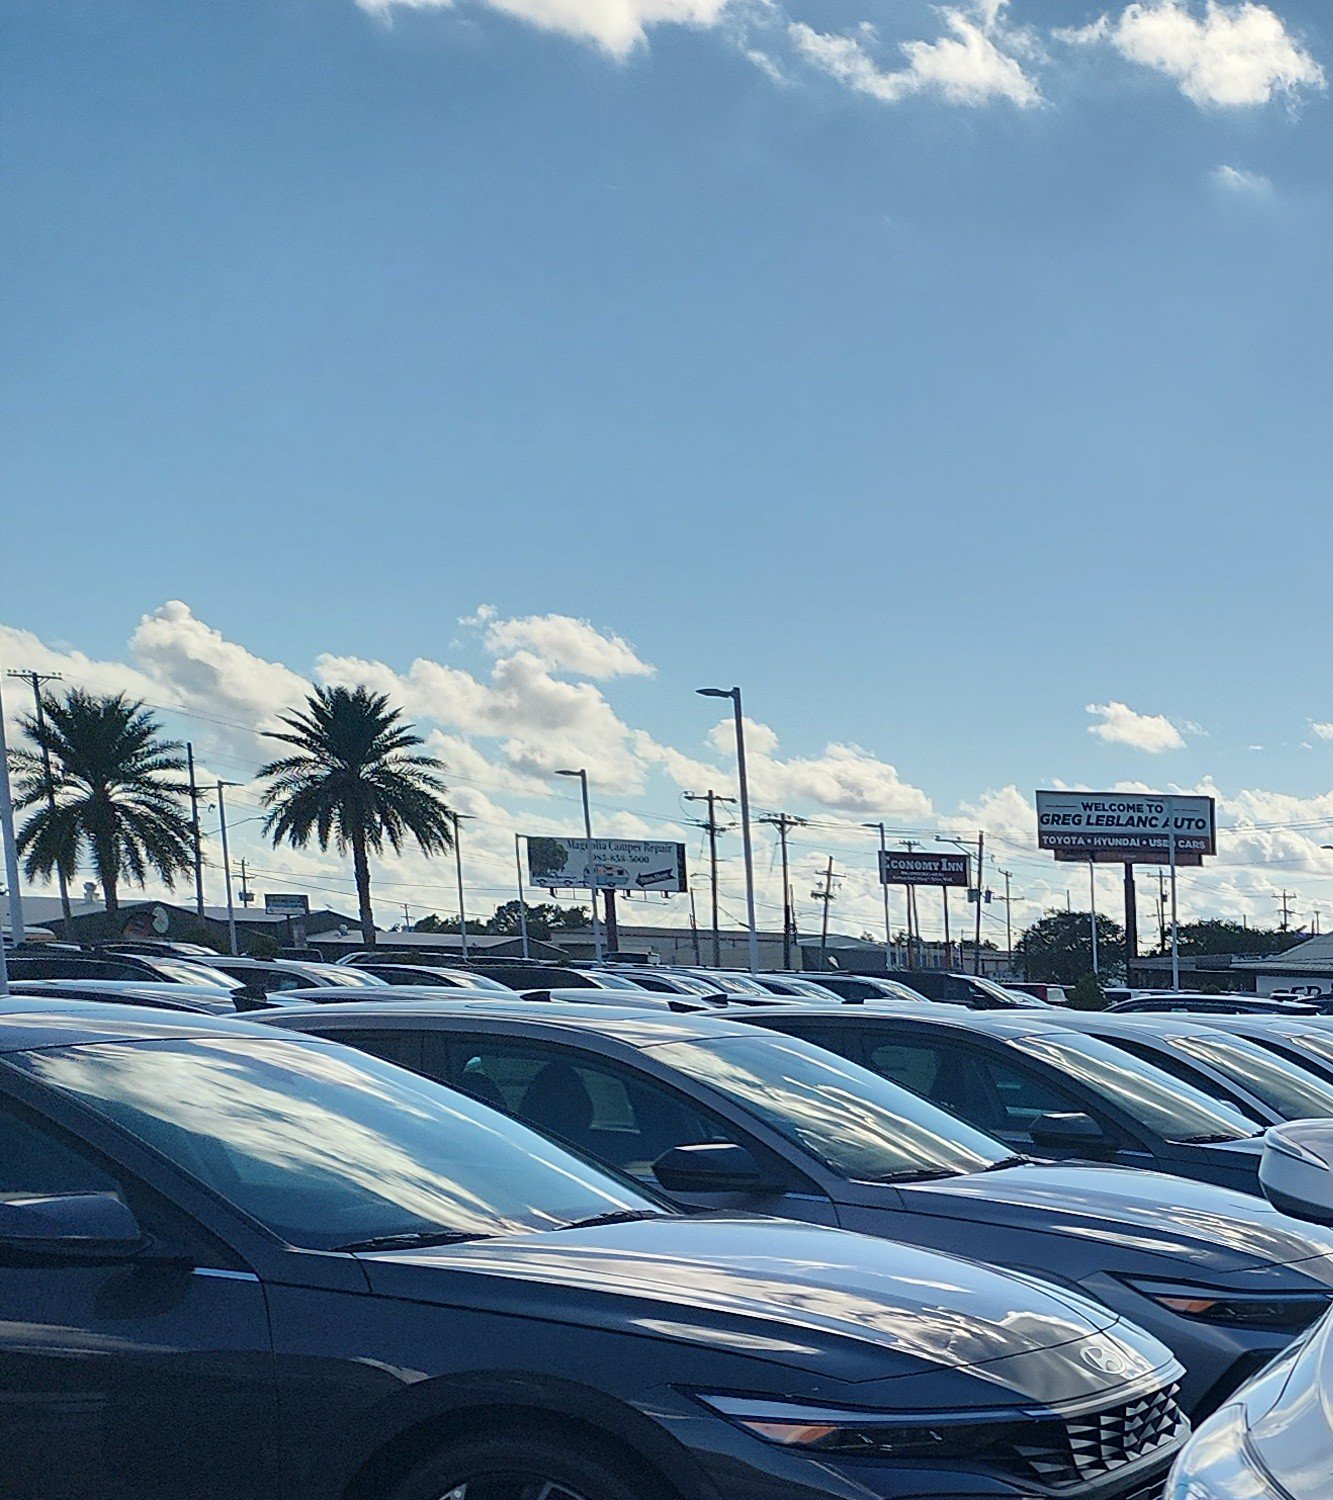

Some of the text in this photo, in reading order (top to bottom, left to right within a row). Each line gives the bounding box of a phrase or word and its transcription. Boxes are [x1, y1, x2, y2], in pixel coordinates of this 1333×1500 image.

[1081, 802, 1163, 814] WELCOME TO
[1040, 813, 1082, 826] GREG
[1085, 815, 1158, 828] LEBLANC
[608, 840, 641, 853] Camper
[643, 841, 672, 853] Repair
[1042, 836, 1205, 849] TOYOTA HYUNDAI USE CARS
[940, 858, 964, 872] INN
